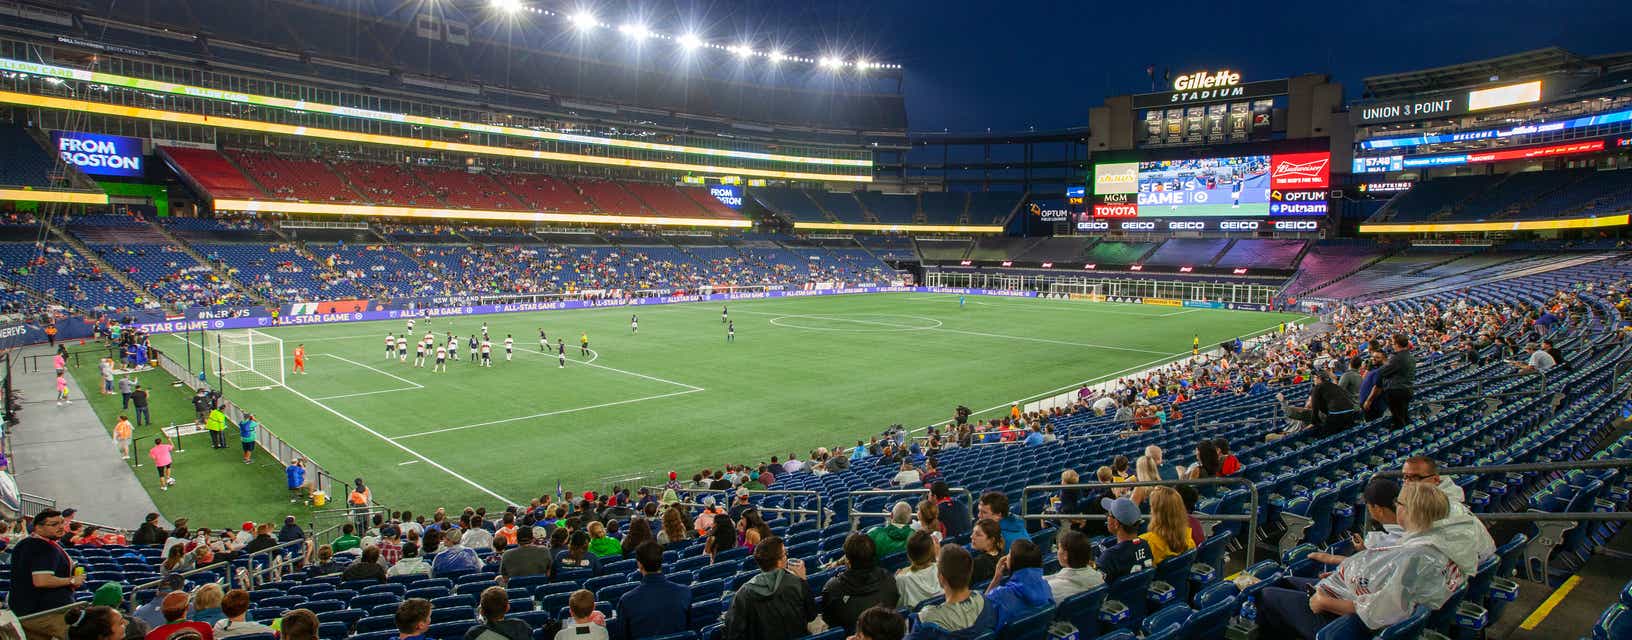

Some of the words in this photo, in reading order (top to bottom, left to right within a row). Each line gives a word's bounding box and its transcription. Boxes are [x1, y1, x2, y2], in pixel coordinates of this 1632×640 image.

[1174, 70, 1240, 90] Gillette
[1171, 87, 1244, 102] STADIUM
[1363, 106, 1400, 120] UNION
[1414, 99, 1452, 114] POINT
[1453, 131, 1493, 140] WELCOME
[59, 137, 116, 154] FROM
[60, 151, 139, 170] BOSTON
[710, 188, 732, 197] FROM
[1286, 192, 1325, 200] OPTUM
[1137, 192, 1183, 204] GAME
[1041, 209, 1068, 217] OPTUM
[1096, 207, 1136, 215] TOYOTA
[1280, 204, 1326, 213] Putnam
[1220, 221, 1258, 229] GEICO
[1275, 221, 1317, 229] GEICO
[504, 303, 537, 311] ALL-STAR
[400, 308, 439, 317] ALL-SAR
[323, 313, 350, 322] GAME
[175, 321, 208, 330] GAME
[1135, 548, 1146, 561] LEE
